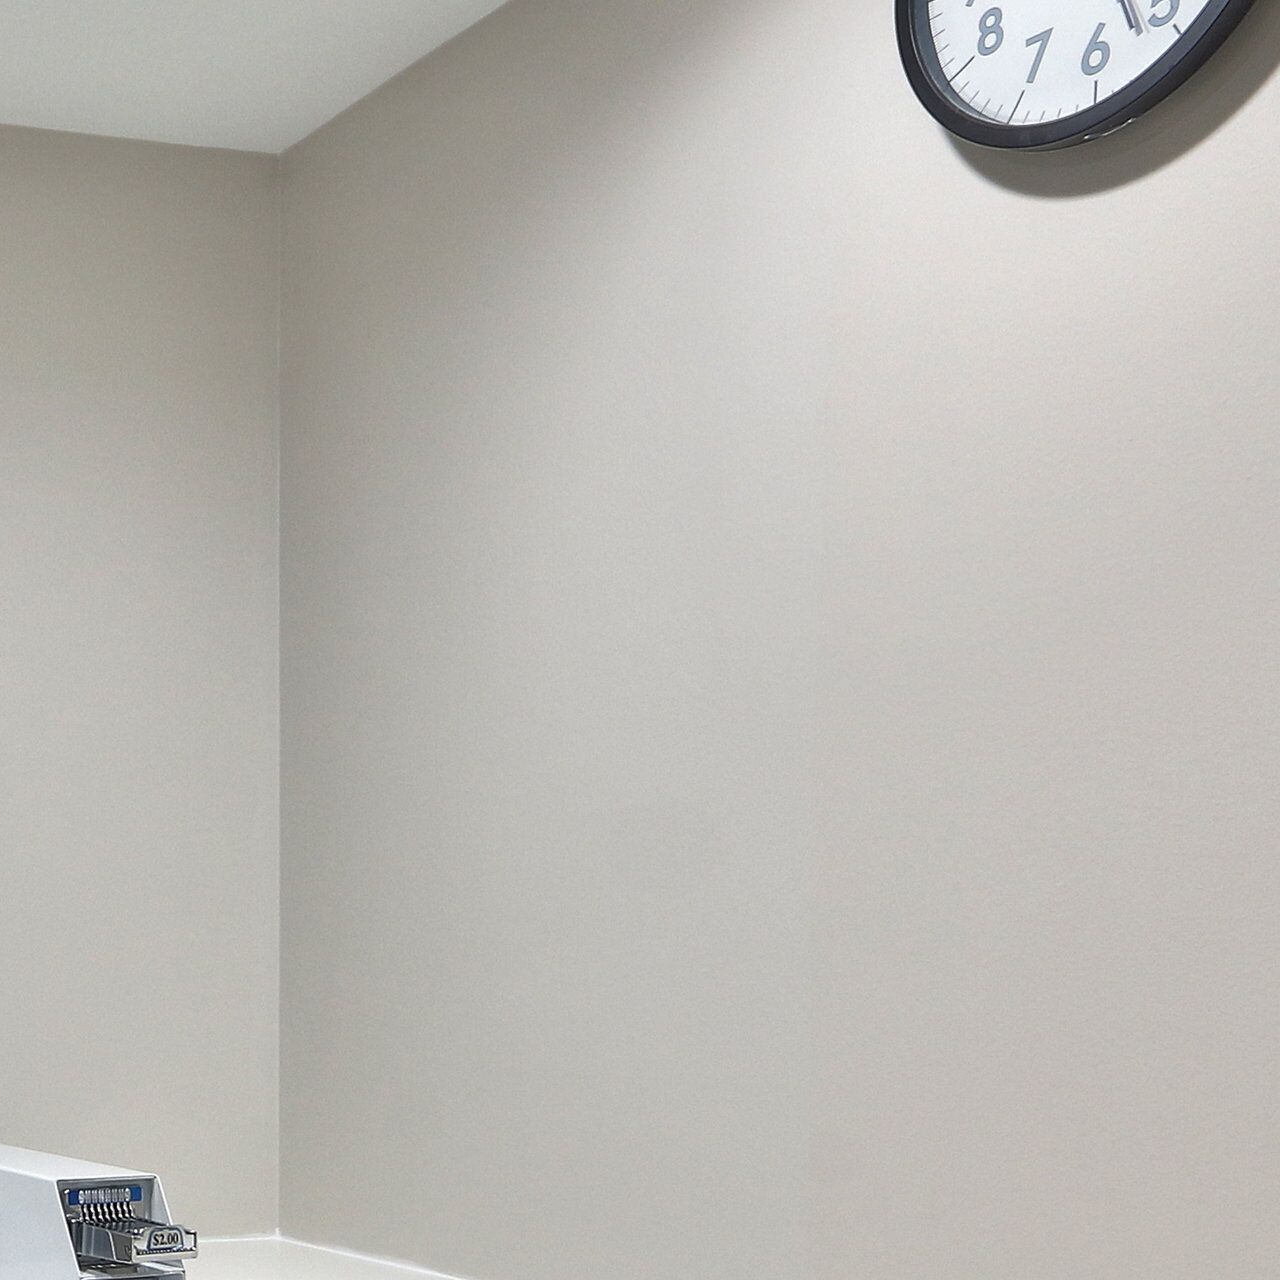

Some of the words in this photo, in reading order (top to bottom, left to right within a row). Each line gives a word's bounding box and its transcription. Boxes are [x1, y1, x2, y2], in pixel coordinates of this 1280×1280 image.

[977, 7, 1005, 56] 8
[1025, 27, 1054, 84] 7
[1081, 22, 1111, 76] 6
[152, 1232, 179, 1247] $2.00
